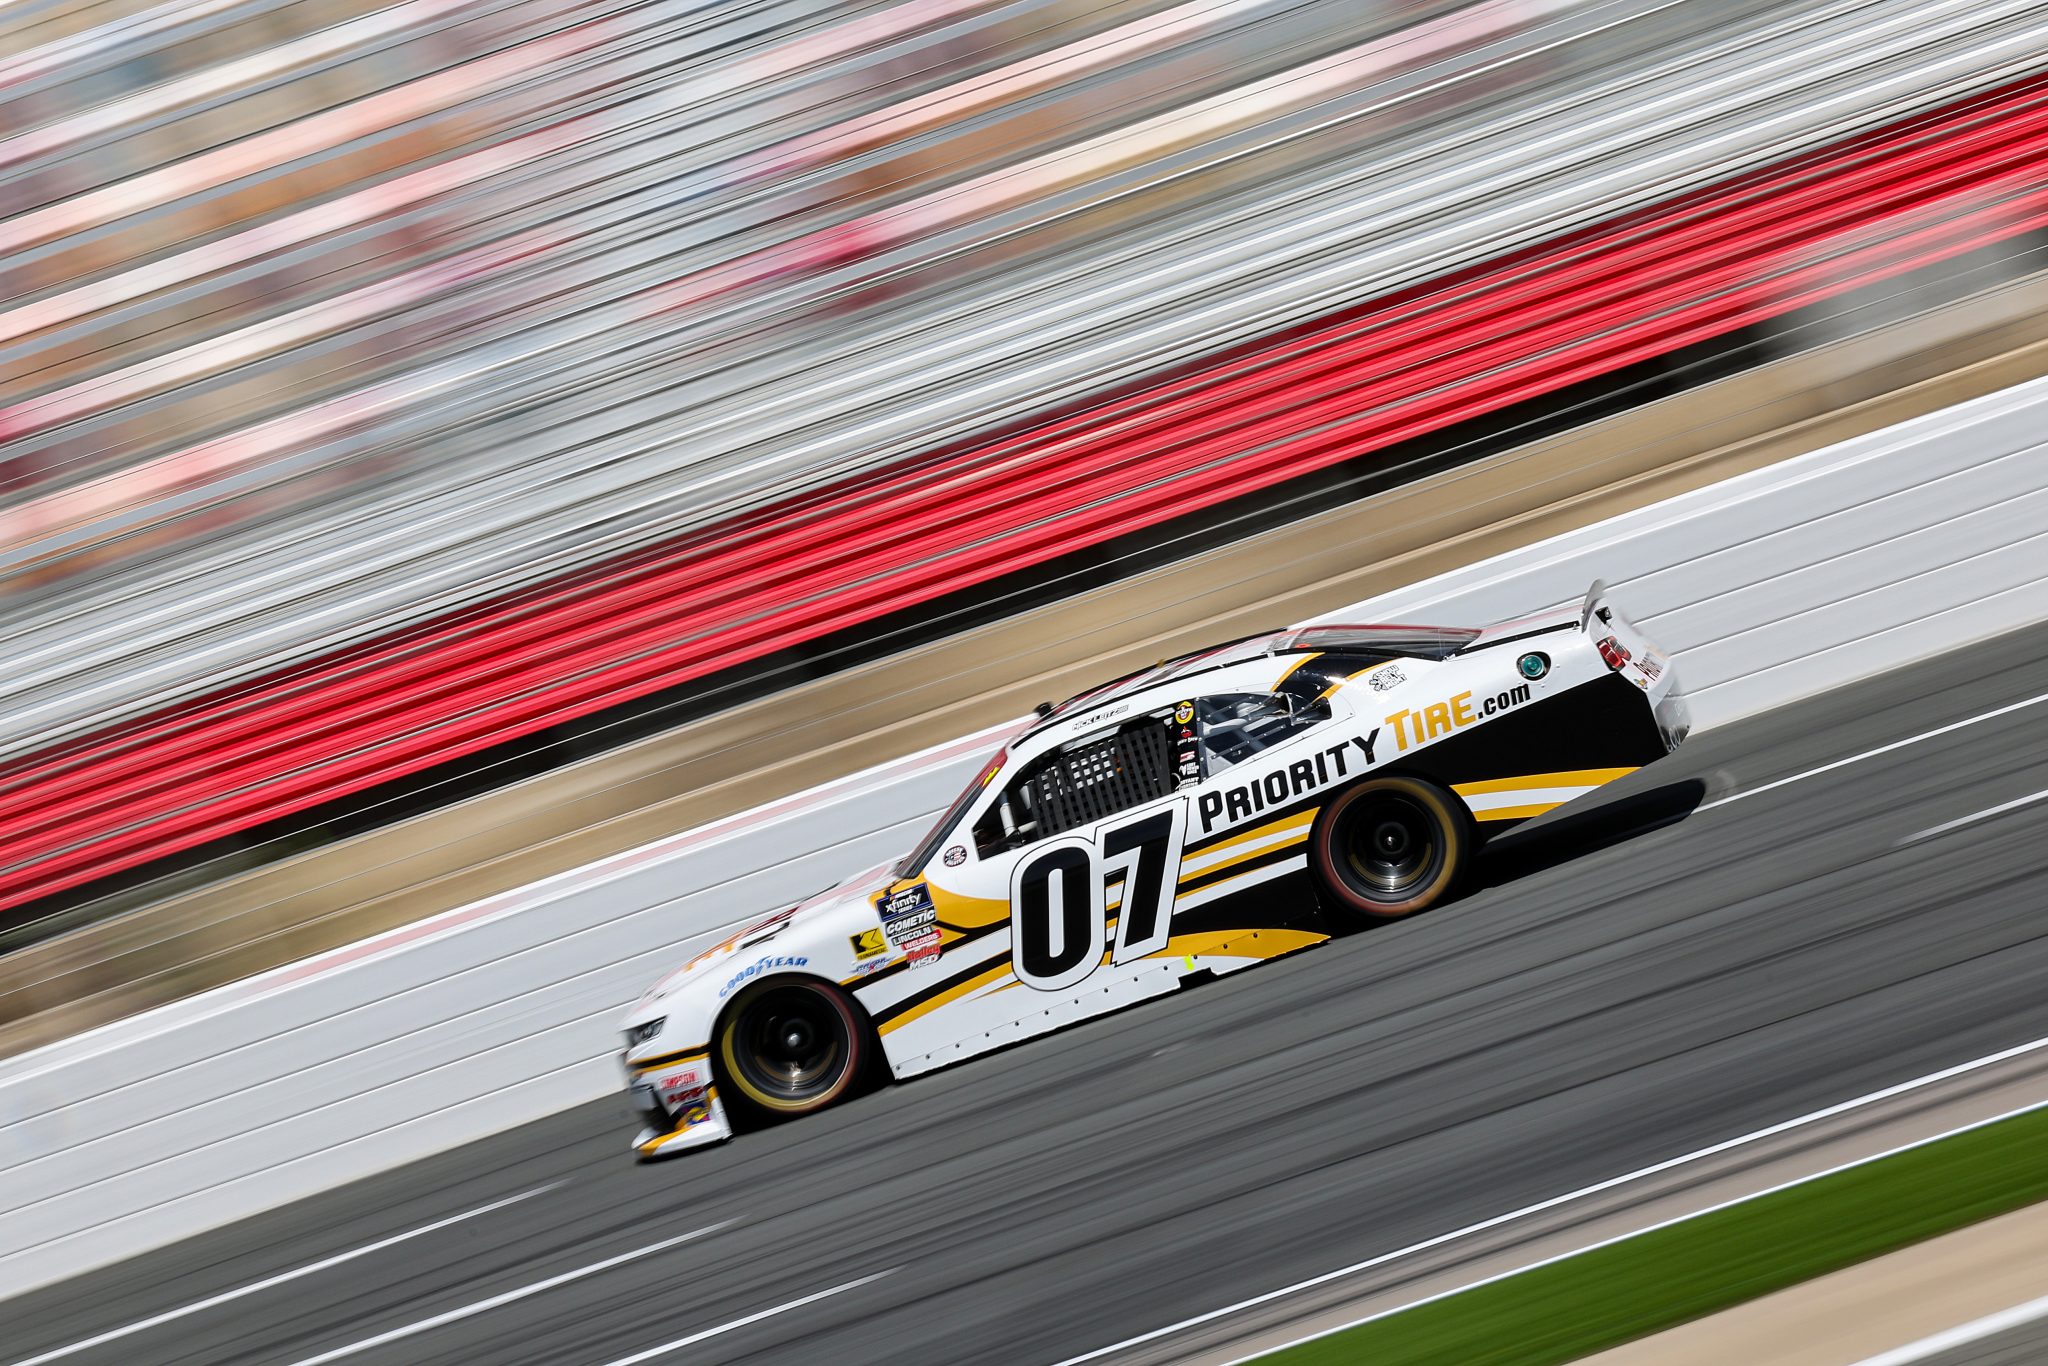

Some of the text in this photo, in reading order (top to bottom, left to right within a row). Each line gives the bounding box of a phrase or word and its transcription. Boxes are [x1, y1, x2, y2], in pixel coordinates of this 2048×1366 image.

[1198, 683, 1531, 834] PRIORITY TIRE.com
[884, 892, 922, 912] xfinity
[1020, 808, 1174, 978] 07
[886, 909, 935, 934] COMETIC
[893, 926, 931, 945] LINCOLN
[719, 954, 808, 998] GOODYEAR
